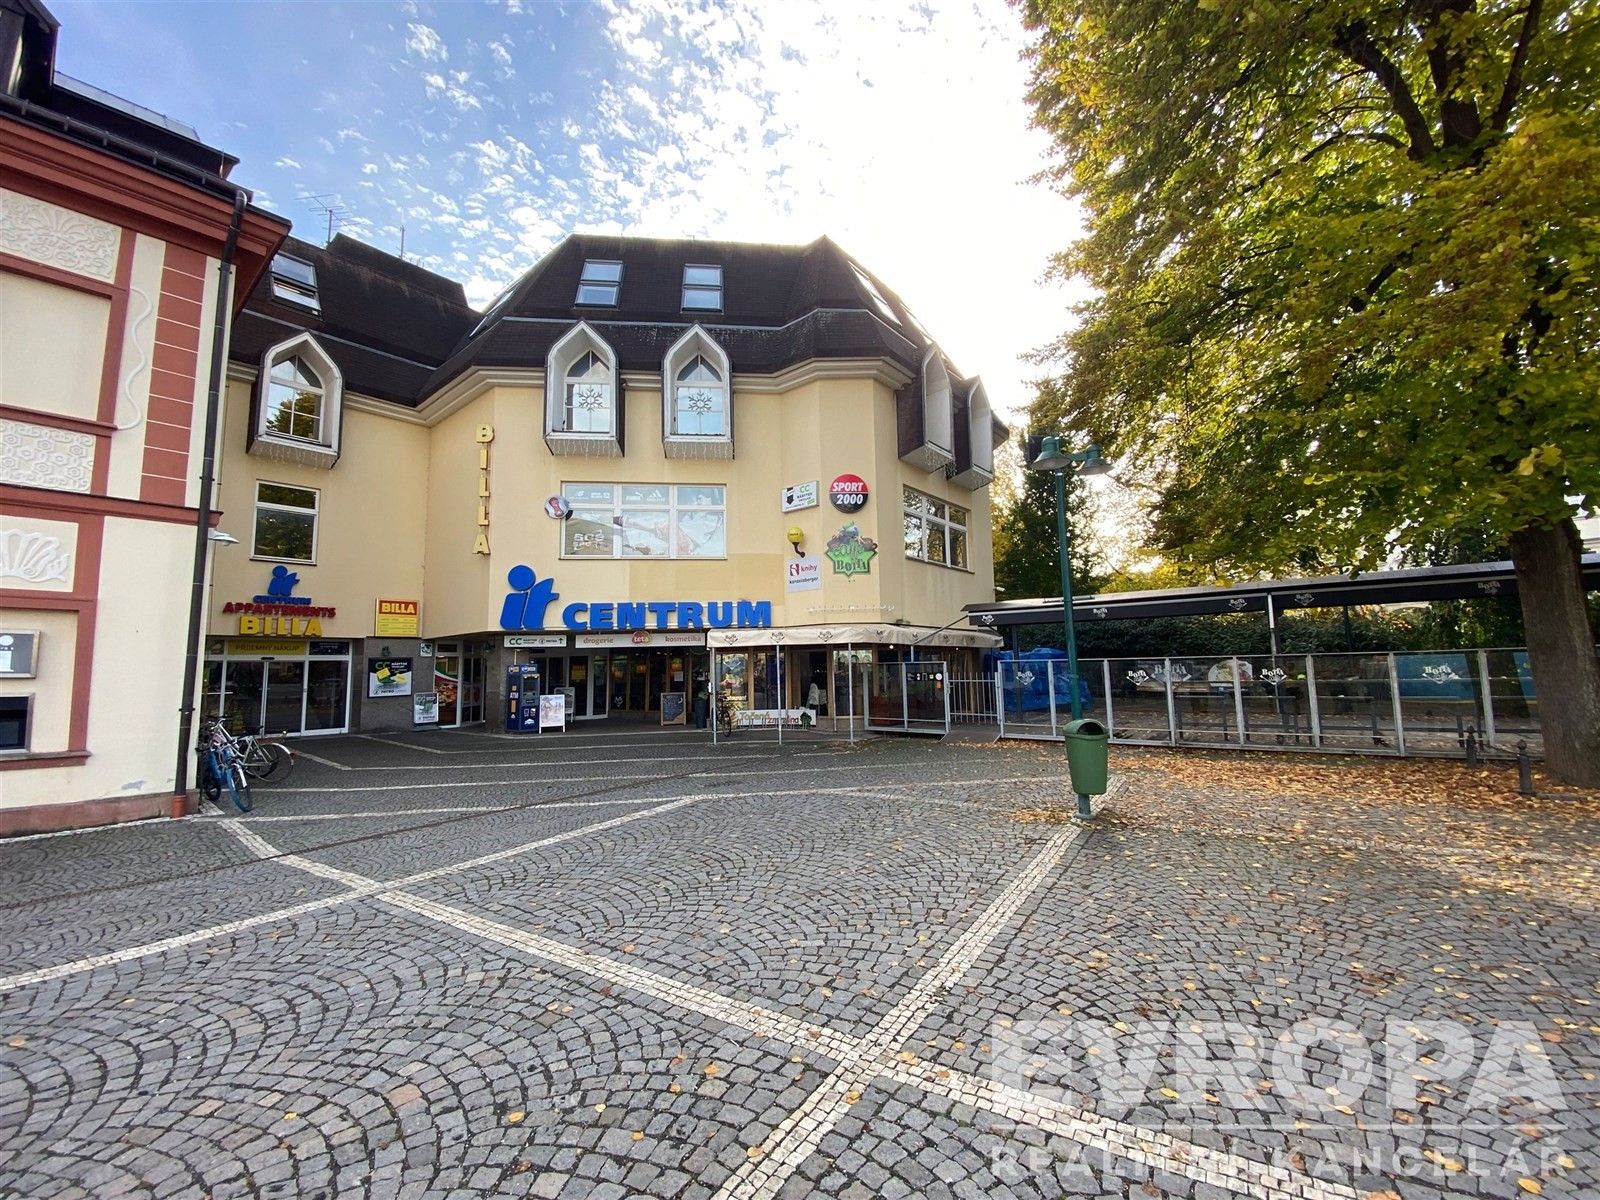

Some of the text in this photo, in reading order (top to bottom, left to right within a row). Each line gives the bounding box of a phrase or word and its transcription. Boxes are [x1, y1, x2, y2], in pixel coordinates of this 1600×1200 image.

[472, 424, 494, 555] BILLA
[832, 482, 864, 492] SPORT
[836, 494, 864, 505] 2000
[801, 564, 817, 572] knihy
[223, 602, 337, 617] APPARTEMENTS
[381, 602, 416, 614] BILLA
[562, 599, 772, 631] CENTRUM
[239, 616, 322, 637] BILLA
[509, 638, 522, 646] CC
[583, 636, 614, 646] drogerie
[665, 634, 702, 643] kosmetika
